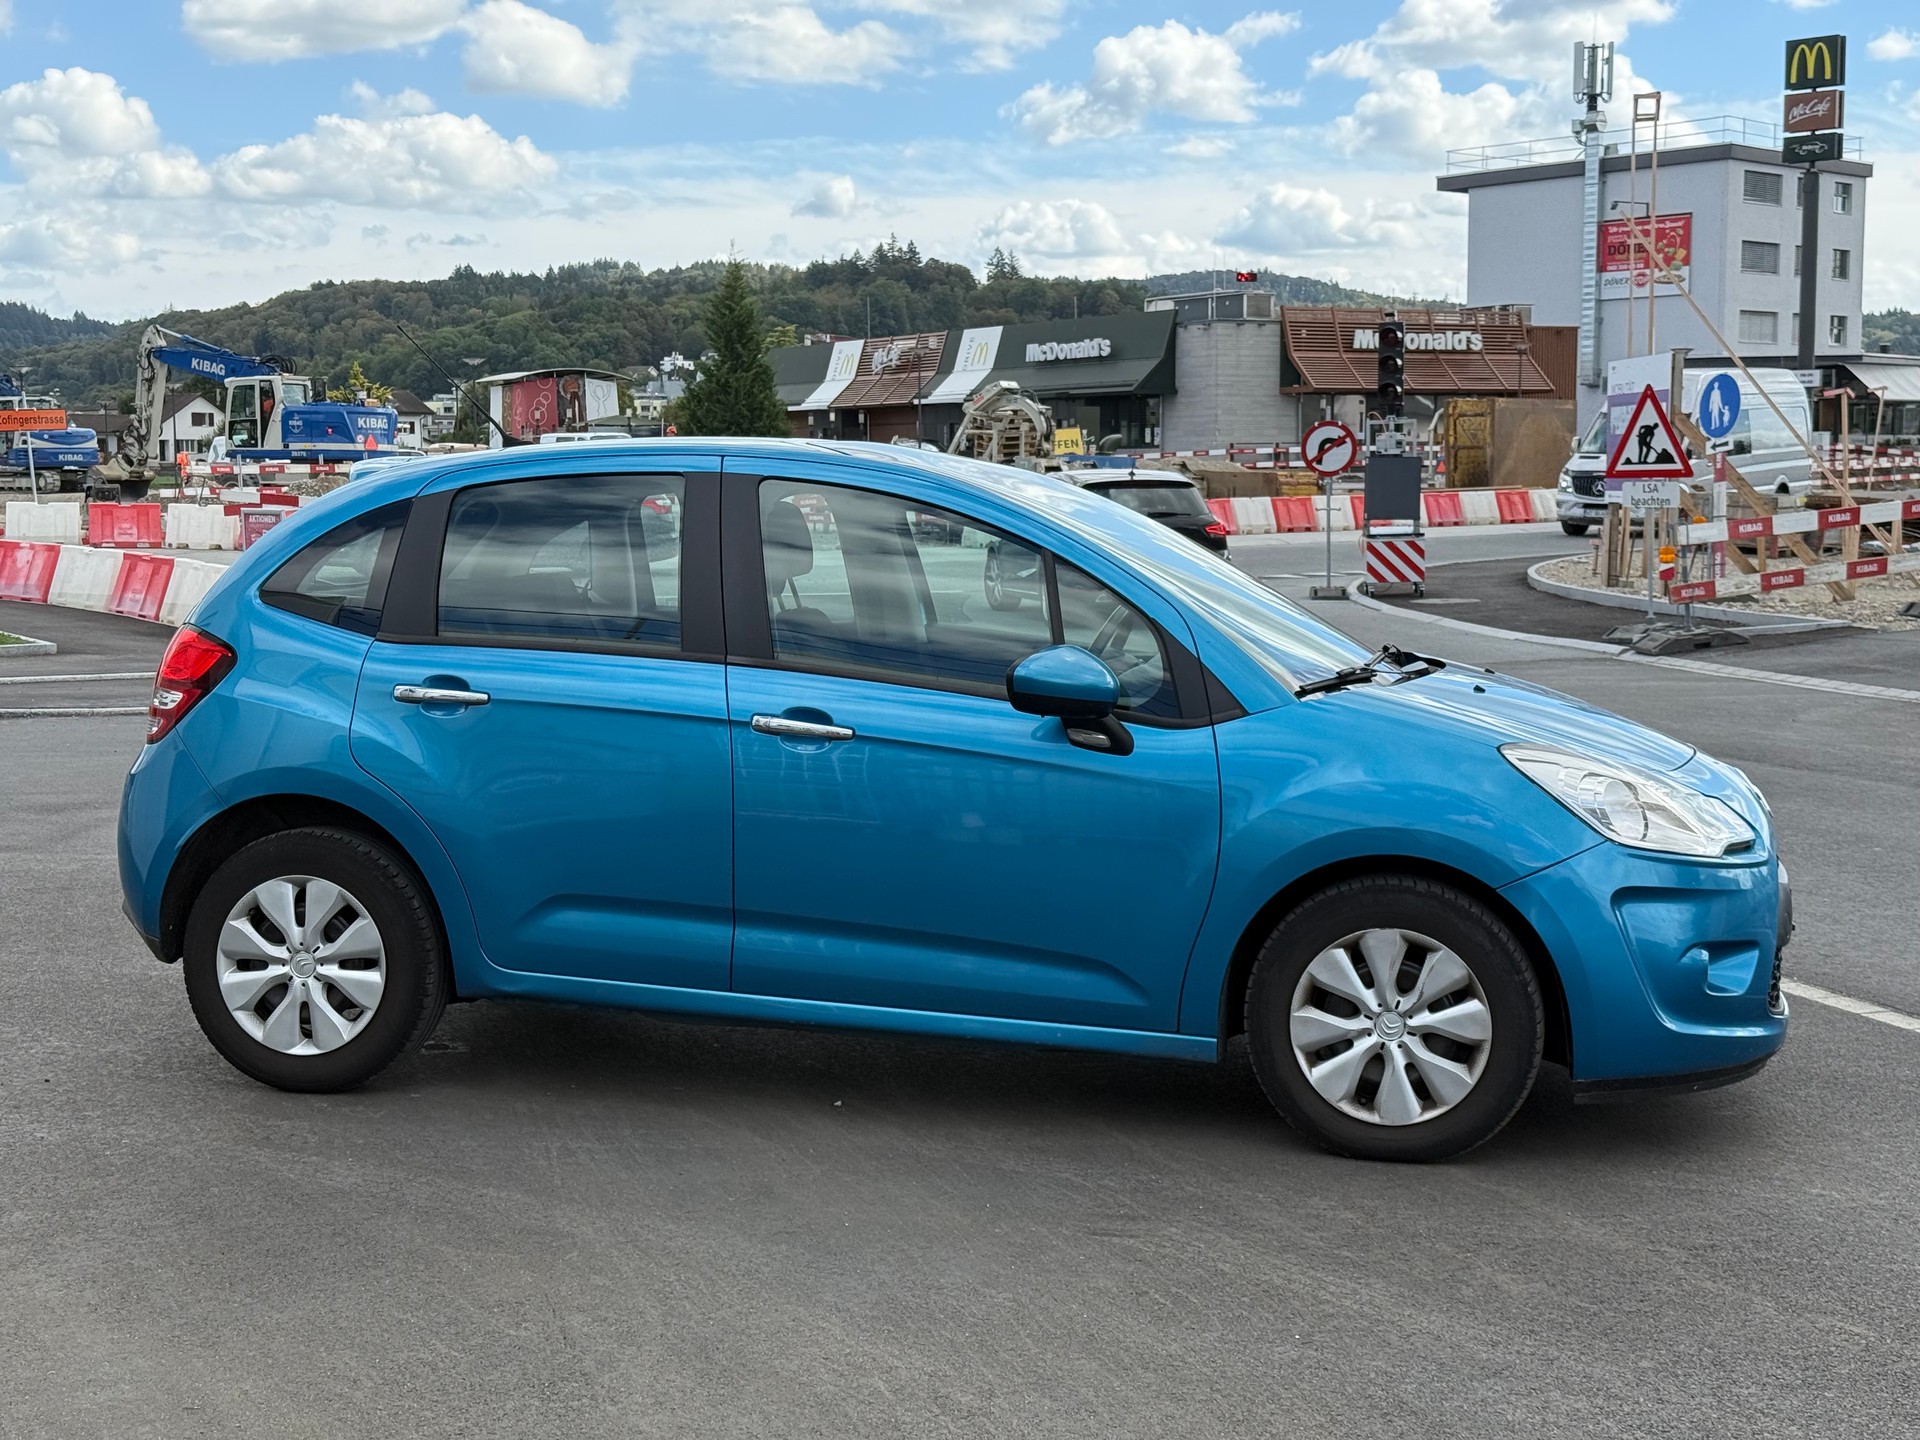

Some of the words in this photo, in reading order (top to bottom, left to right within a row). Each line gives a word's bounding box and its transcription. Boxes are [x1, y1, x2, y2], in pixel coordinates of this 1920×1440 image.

[962, 337, 975, 371] DRIVE
[1025, 338, 1111, 362] McDonald's
[191, 357, 225, 376] KIBAG
[357, 417, 388, 429] KIBAG
[58, 453, 84, 461] KIBAG
[1642, 483, 1659, 493] LSA
[1630, 496, 1671, 507] beachten
[248, 515, 276, 524] AKTIONEN
[1828, 511, 1851, 523] KIBAG
[1738, 521, 1763, 533] KIBAG
[1856, 562, 1879, 574] KIBAG
[1771, 574, 1795, 585] KIBAG
[1680, 586, 1706, 598] KIBAG
